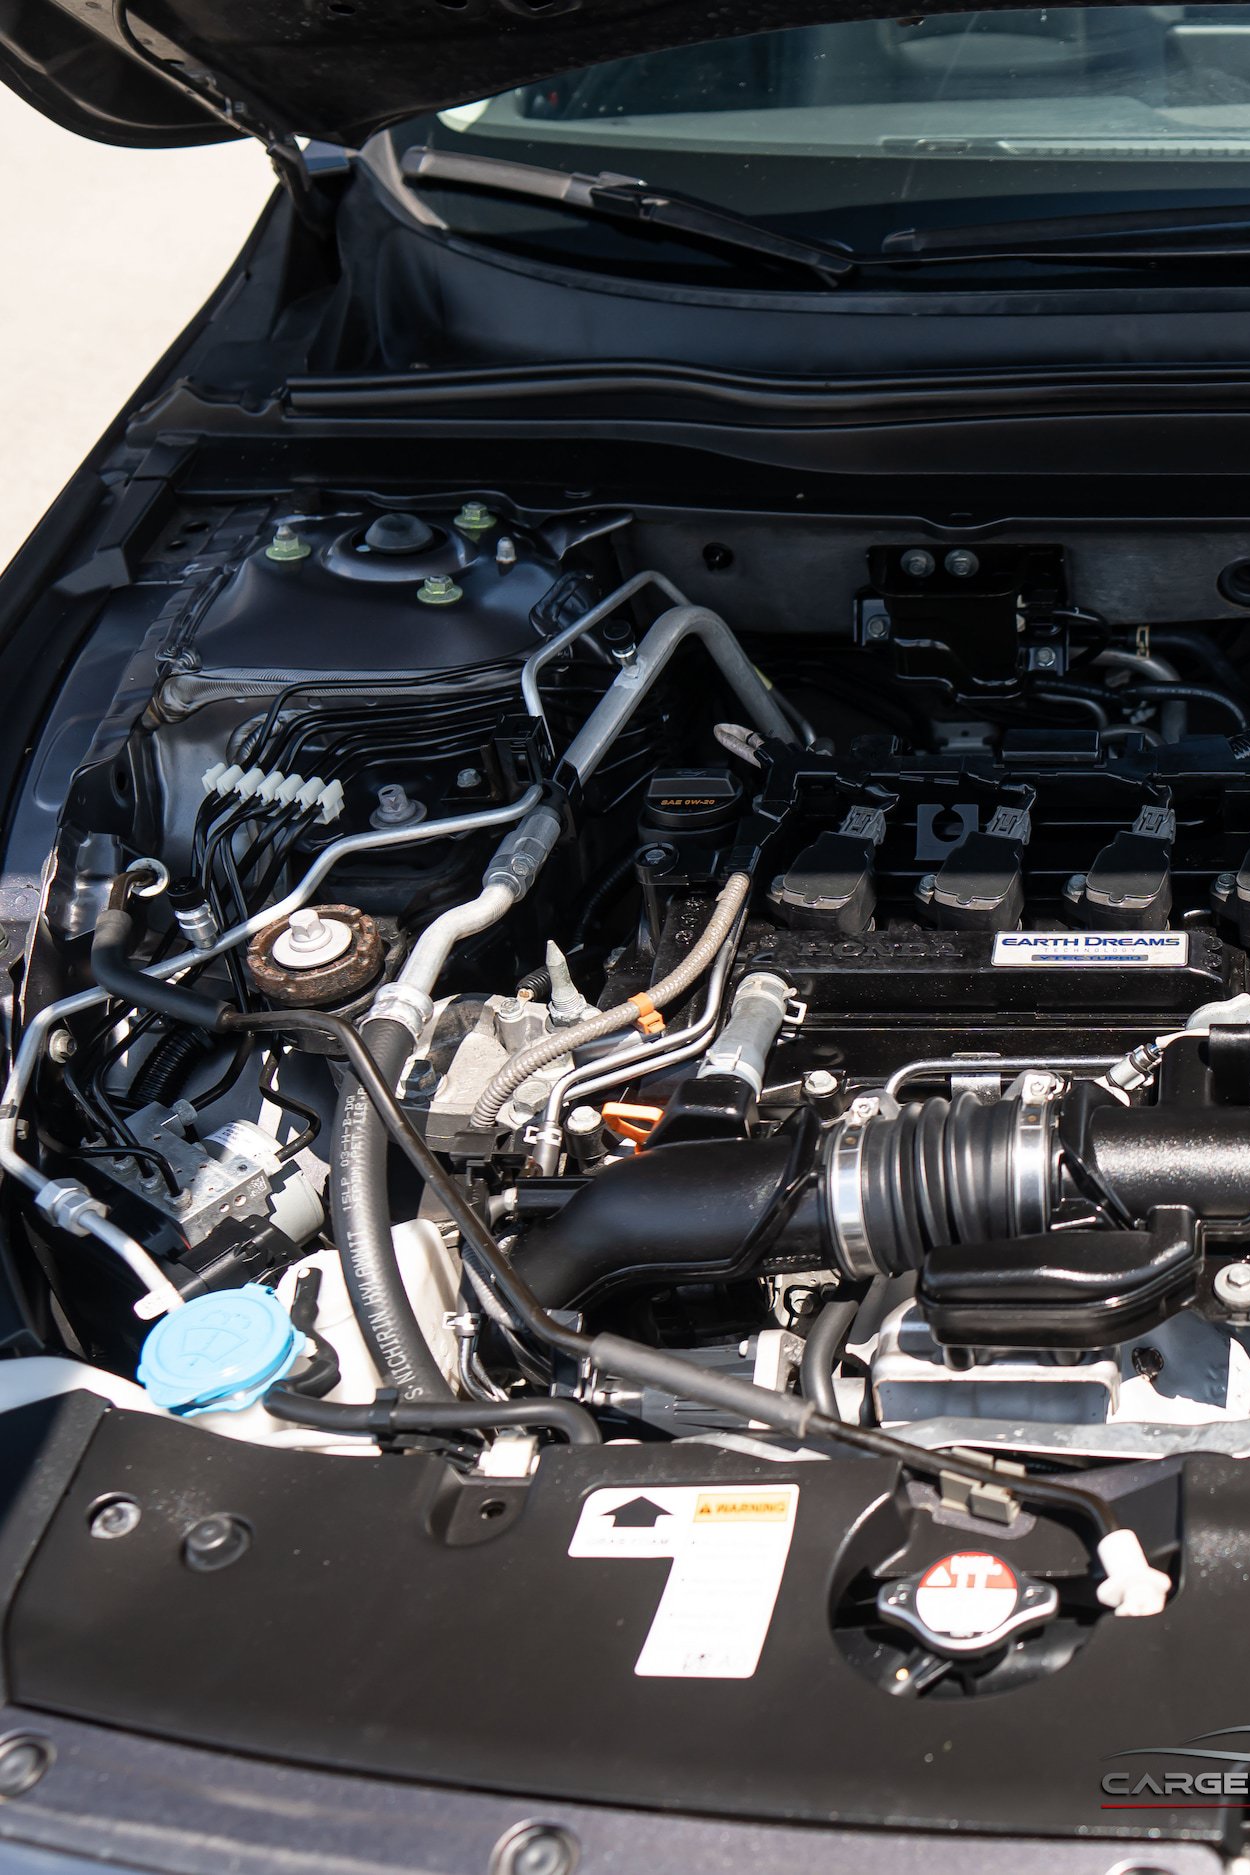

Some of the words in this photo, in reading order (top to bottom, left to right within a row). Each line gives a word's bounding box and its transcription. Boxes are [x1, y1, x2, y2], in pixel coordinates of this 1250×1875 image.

[1001, 938, 1079, 947] EARTH
[1084, 936, 1180, 947] DREAMS
[796, 941, 965, 957] HONDA
